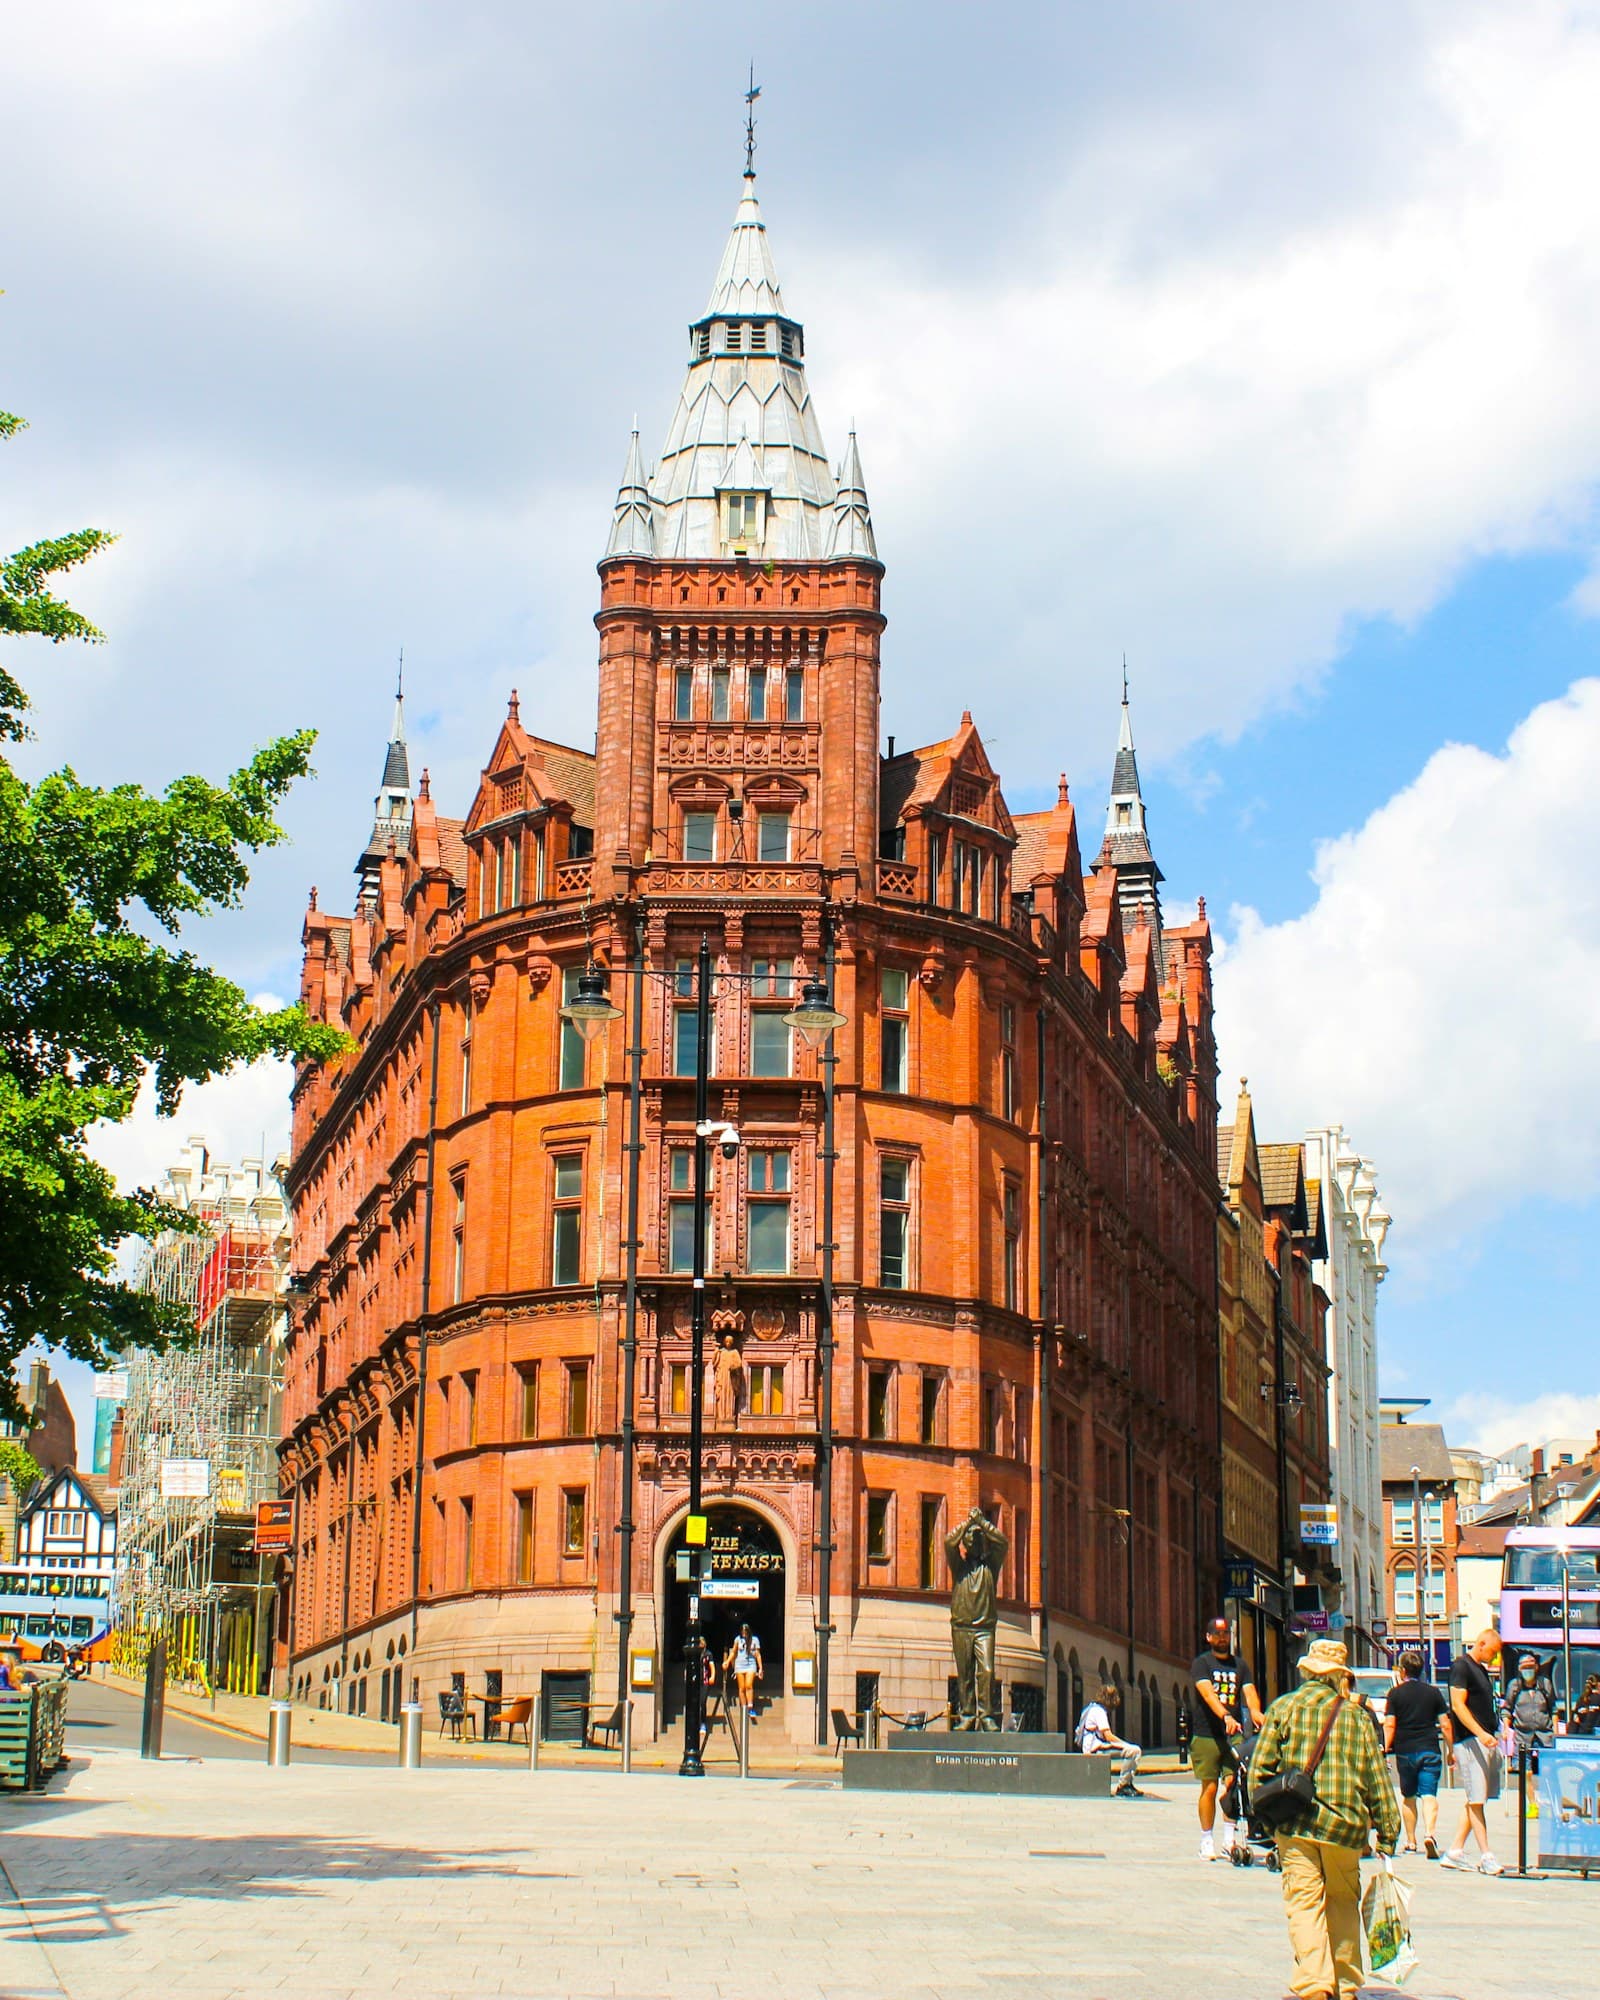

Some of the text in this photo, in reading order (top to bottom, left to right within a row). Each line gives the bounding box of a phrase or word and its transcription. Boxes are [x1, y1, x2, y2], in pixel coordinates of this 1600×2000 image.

[1316, 1525, 1335, 1534] FHP
[711, 1537, 739, 1547] THE
[666, 1555, 783, 1569] AHEMIST
[1550, 1606, 1582, 1617] Caon
[935, 1755, 1019, 1766] Brian Clough OBE
